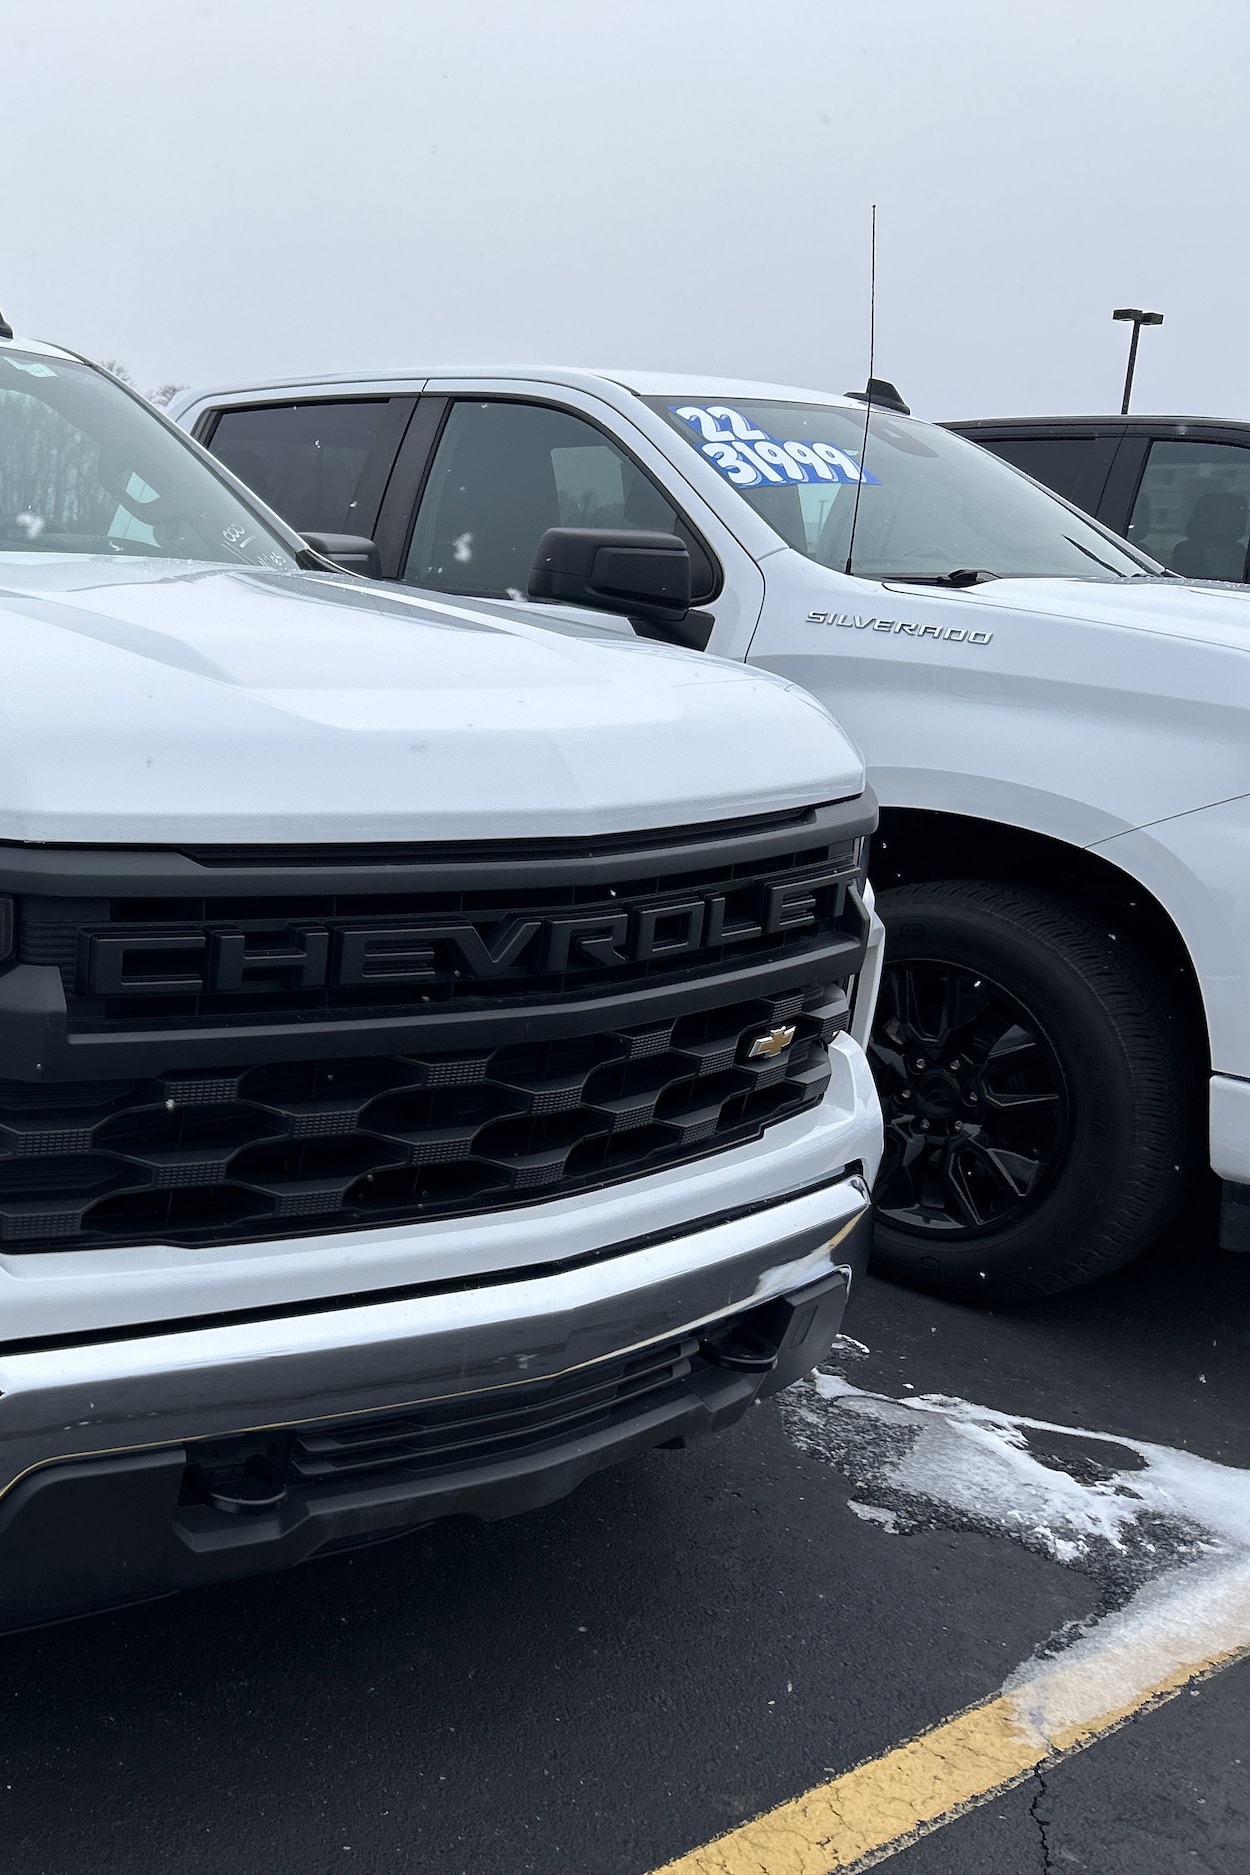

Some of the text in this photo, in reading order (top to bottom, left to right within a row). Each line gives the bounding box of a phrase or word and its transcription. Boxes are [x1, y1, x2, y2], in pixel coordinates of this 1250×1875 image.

[675, 406, 770, 442] 22
[701, 441, 867, 485] 31999
[806, 610, 994, 645] SILVERADO
